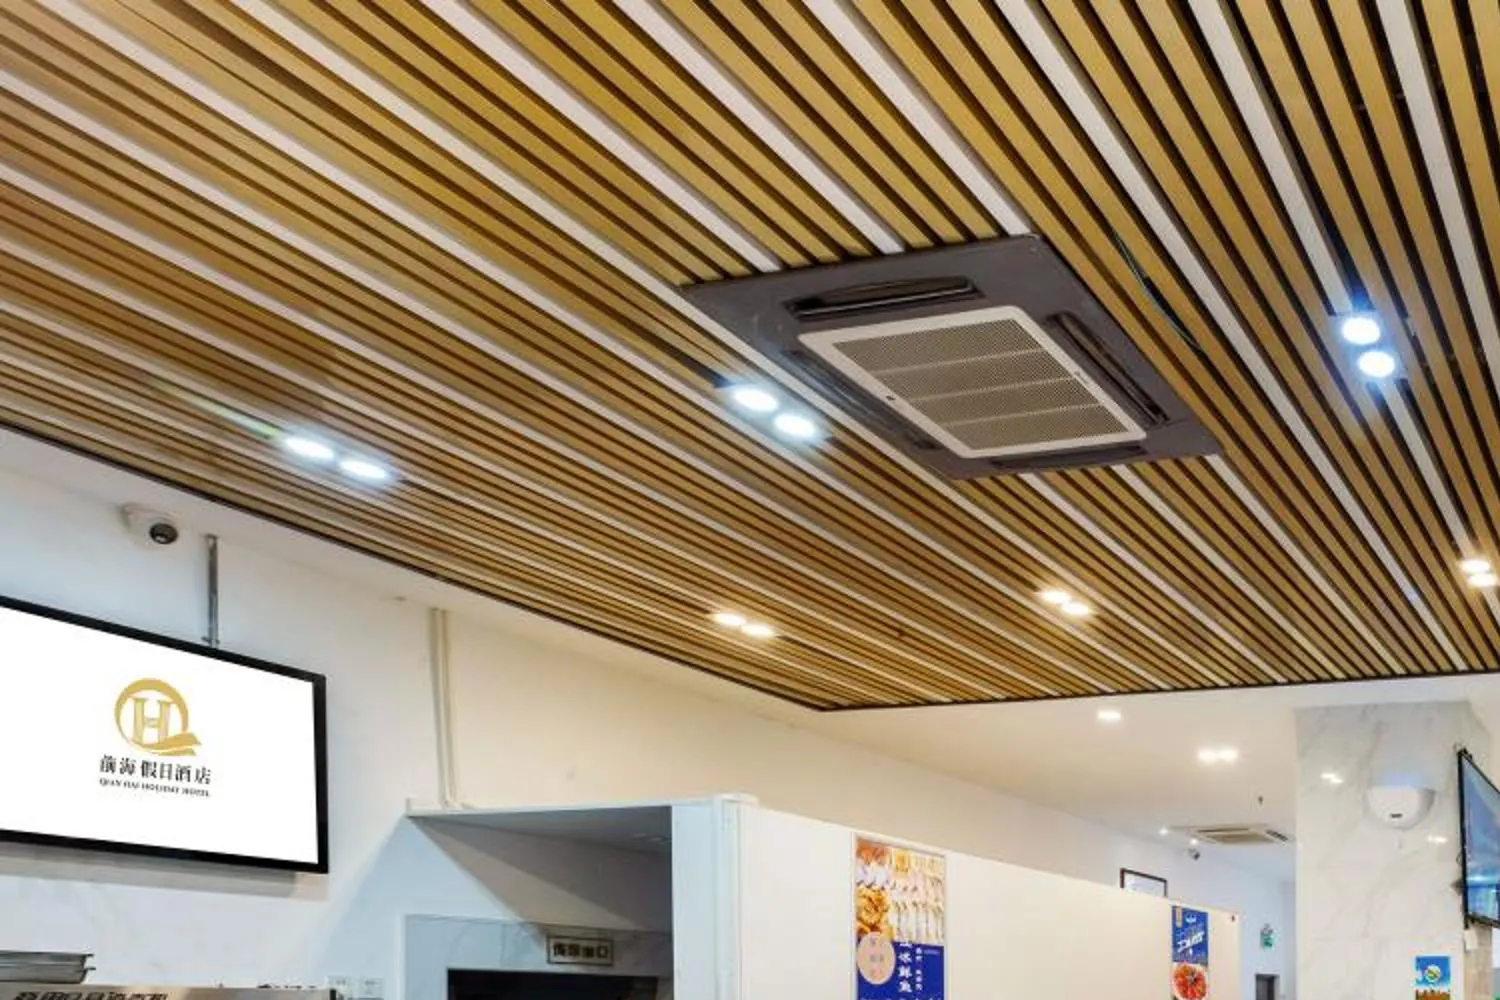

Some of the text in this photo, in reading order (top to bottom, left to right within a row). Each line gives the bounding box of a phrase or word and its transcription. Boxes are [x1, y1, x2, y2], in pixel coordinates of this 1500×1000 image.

[99, 754, 211, 785] 前海假日酒店
[182, 786, 209, 797] HOTEL
